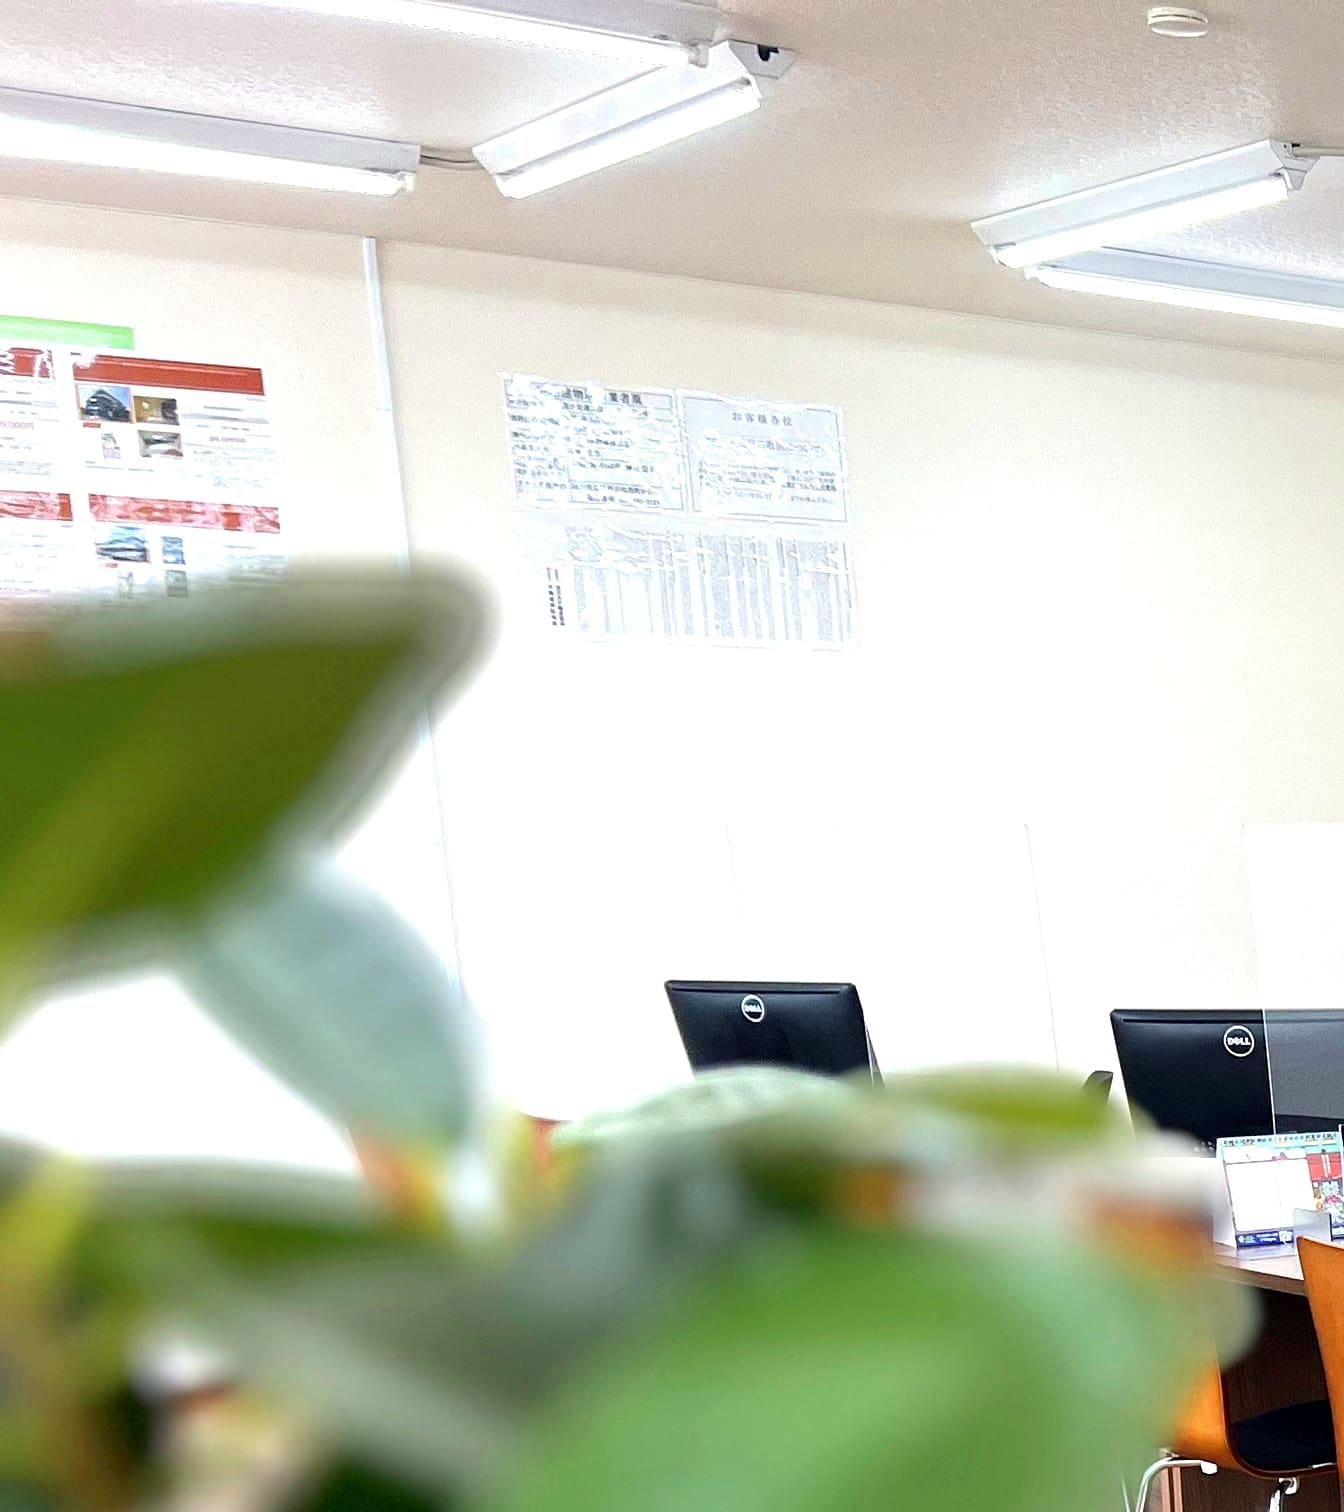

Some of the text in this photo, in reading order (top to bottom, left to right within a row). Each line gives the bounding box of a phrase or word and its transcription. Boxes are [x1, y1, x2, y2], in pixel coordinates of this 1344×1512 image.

[731, 411, 793, 427] お客様各位
[1226, 1035, 1252, 1046] DELL
